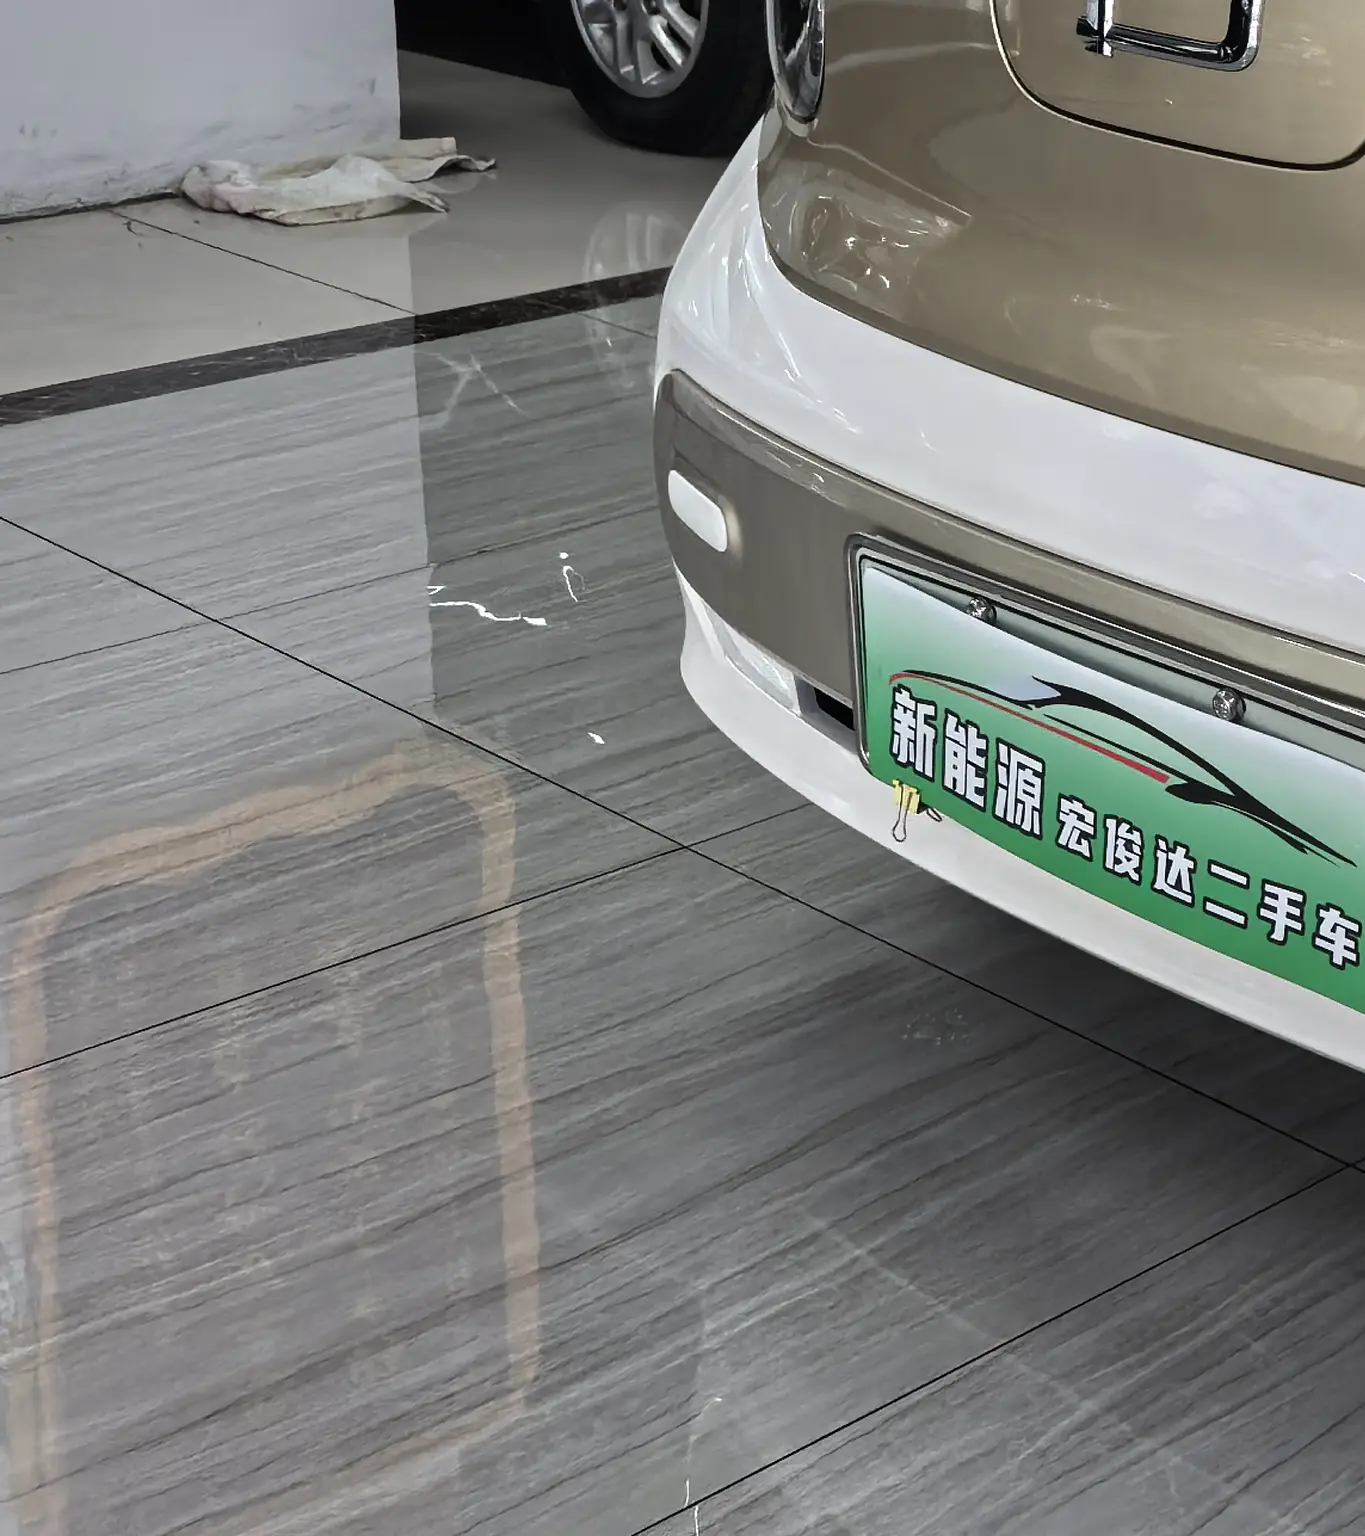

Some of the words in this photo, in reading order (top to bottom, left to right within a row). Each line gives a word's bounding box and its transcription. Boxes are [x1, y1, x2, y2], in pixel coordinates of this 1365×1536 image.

[889, 685, 1046, 838] 新能源
[1056, 793, 1362, 968] 宏俊达二手车
